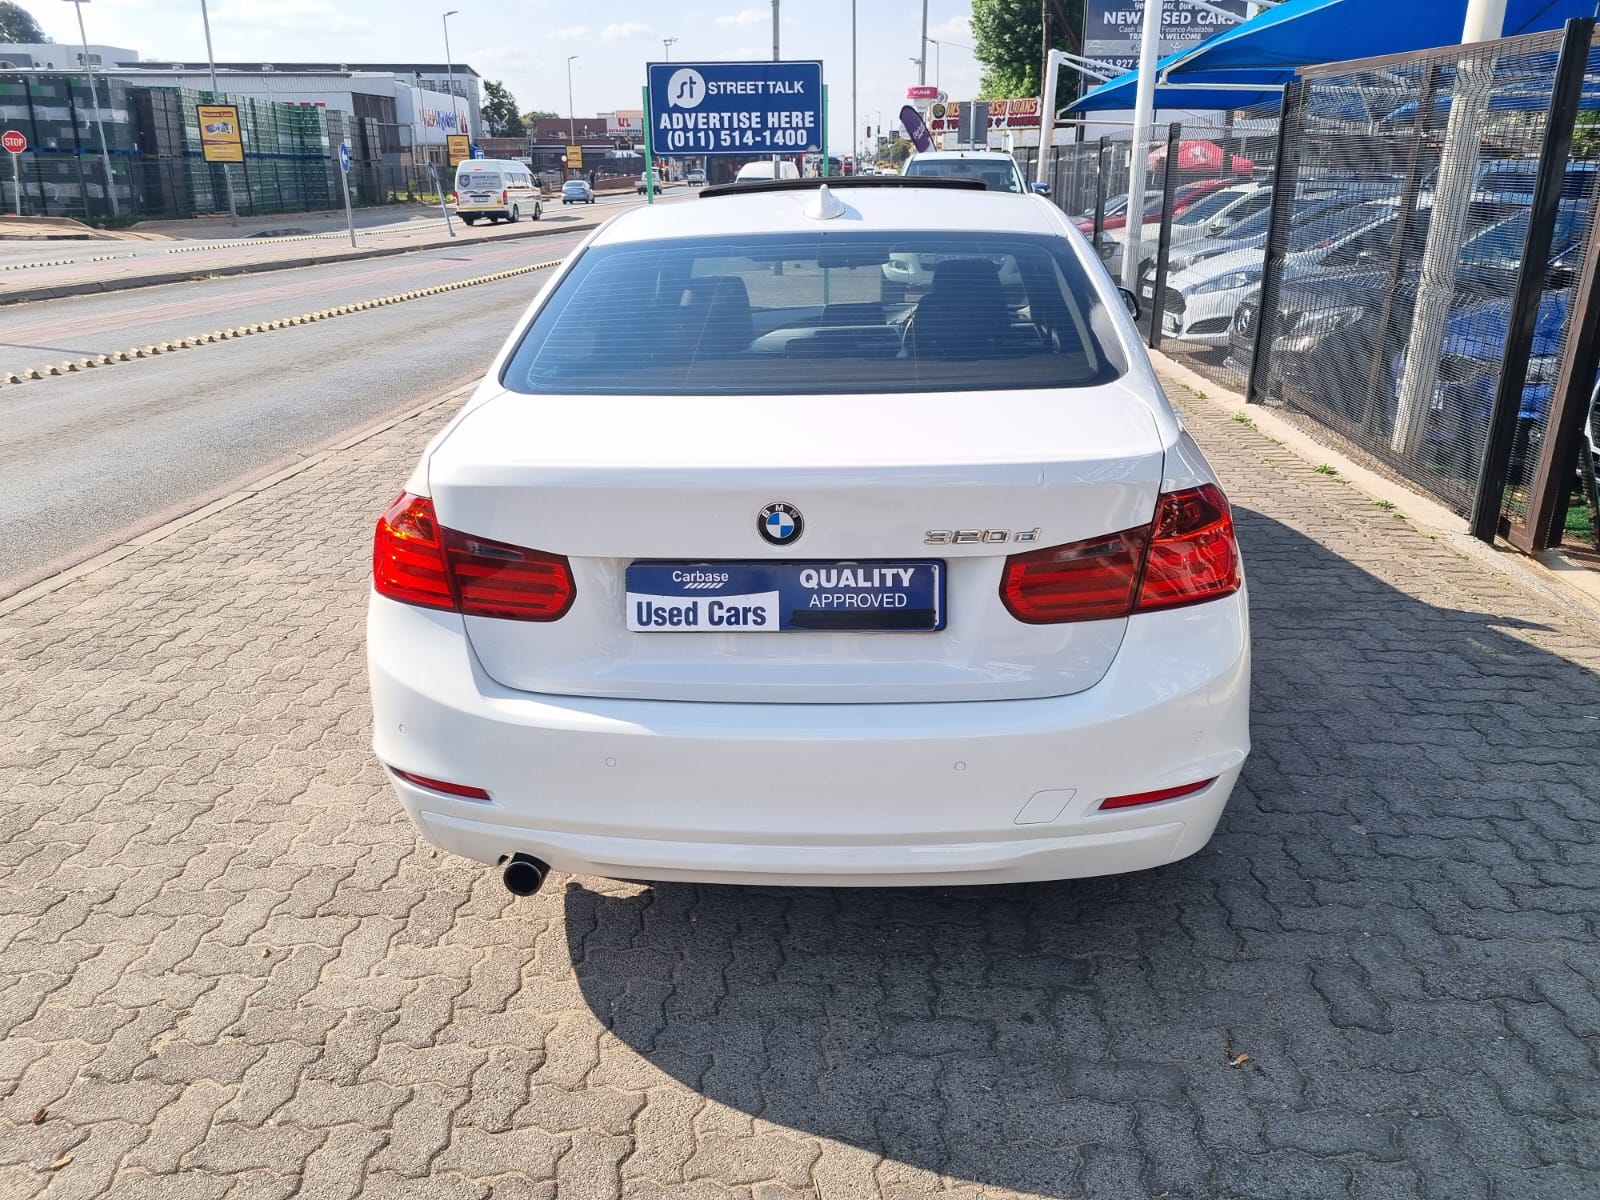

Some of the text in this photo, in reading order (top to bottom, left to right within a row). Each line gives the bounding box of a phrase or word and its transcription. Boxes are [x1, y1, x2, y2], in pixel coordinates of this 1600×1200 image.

[1103, 12, 1142, 24] NEW
[1162, 12, 1191, 24] SED
[1119, 25, 1136, 33] Cash
[1161, 25, 1184, 33] Finance
[1185, 25, 1214, 33] Available
[1116, 59, 1134, 68] 927
[708, 81, 767, 95] STREET
[767, 80, 805, 94] TALK
[988, 100, 1038, 116] ASH LOANS
[659, 111, 815, 129] ADVERTISE HERE
[5, 137, 24, 147] STOP
[667, 129, 808, 150] (011) 514-1400
[762, 504, 800, 519] BMW
[923, 527, 1041, 545] 320d
[672, 570, 729, 582] Carbase
[799, 568, 915, 589] QUALITY
[809, 593, 907, 608] APPROVED
[636, 600, 767, 627] Used Cars
